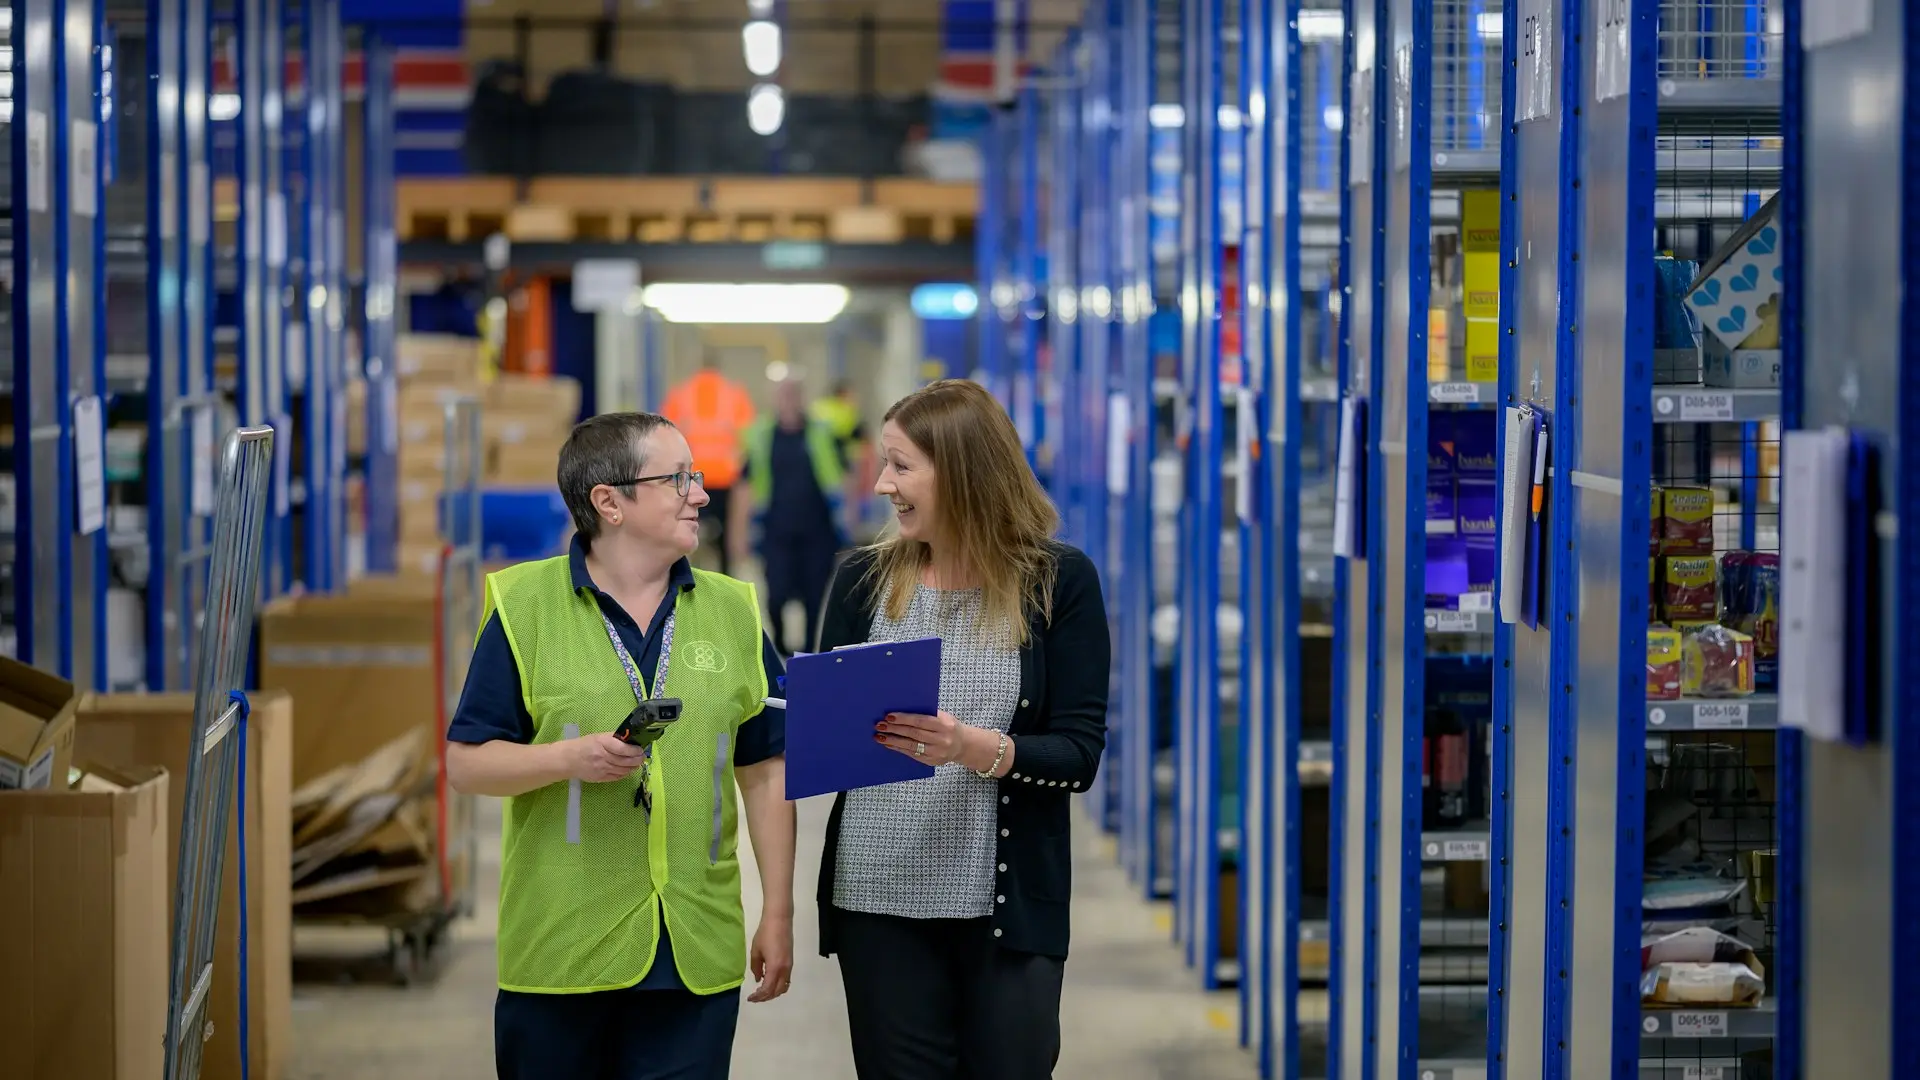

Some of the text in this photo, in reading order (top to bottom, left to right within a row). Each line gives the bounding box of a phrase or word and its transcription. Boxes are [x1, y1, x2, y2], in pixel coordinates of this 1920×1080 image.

[1673, 560, 1709, 571] Anadin
[1700, 706, 1741, 717] D05-100
[1678, 1014, 1720, 1026] D05-150
